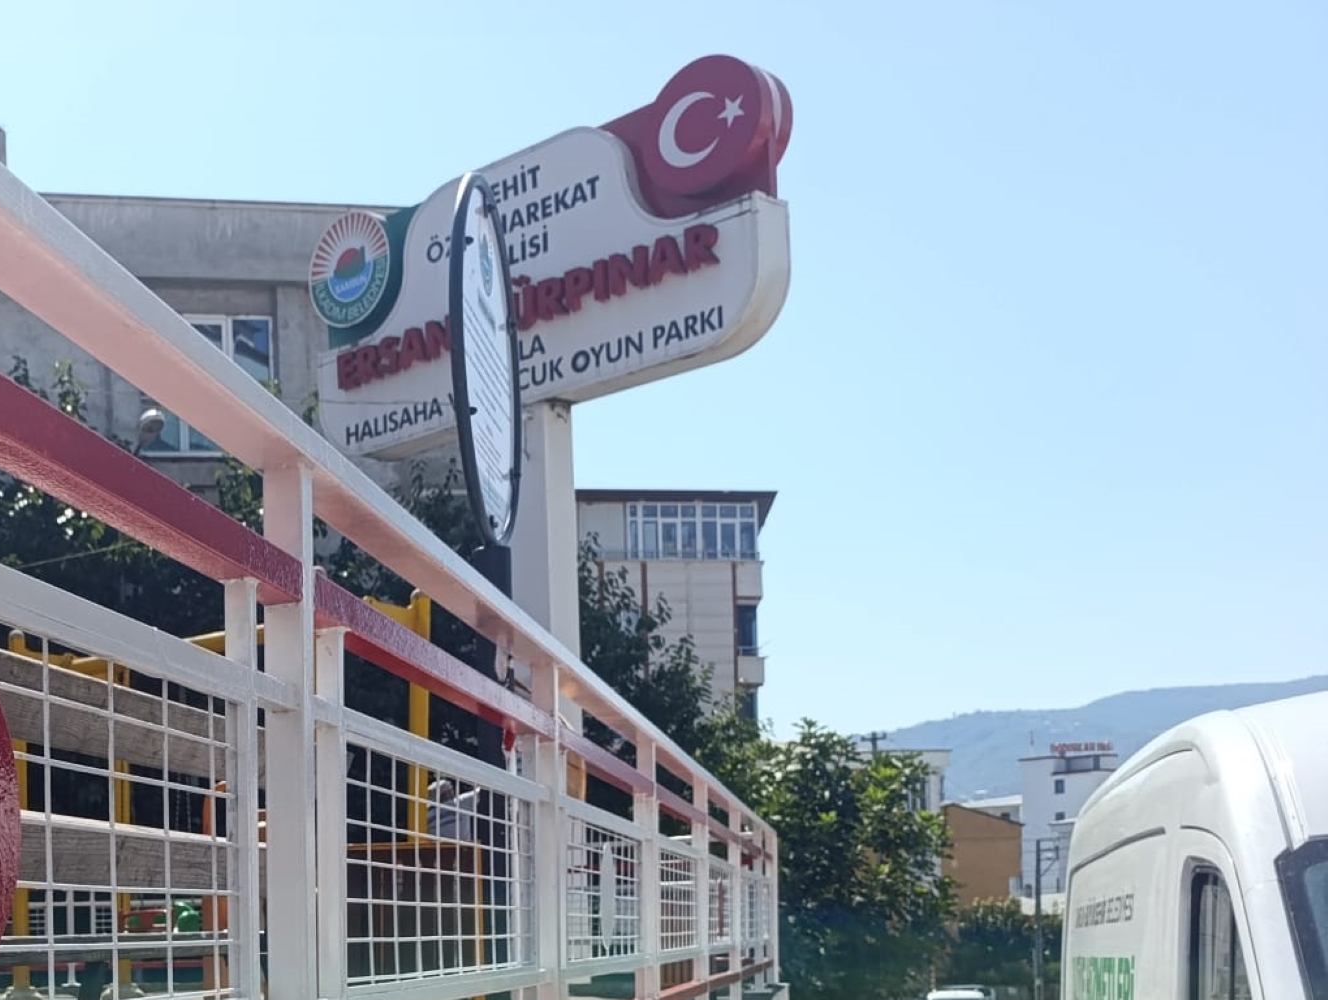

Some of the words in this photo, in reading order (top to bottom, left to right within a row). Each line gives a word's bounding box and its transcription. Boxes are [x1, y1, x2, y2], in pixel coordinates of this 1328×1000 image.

[490, 164, 541, 205] EHİT
[508, 224, 549, 266] LİSİ
[336, 314, 451, 392] ERSAN
[511, 223, 720, 332] ÜRPINAR
[517, 333, 546, 361] LA
[345, 397, 443, 446] HALISAHA
[518, 356, 564, 391] CUK
[571, 331, 643, 374] OYUN
[652, 305, 724, 349] PARKI
